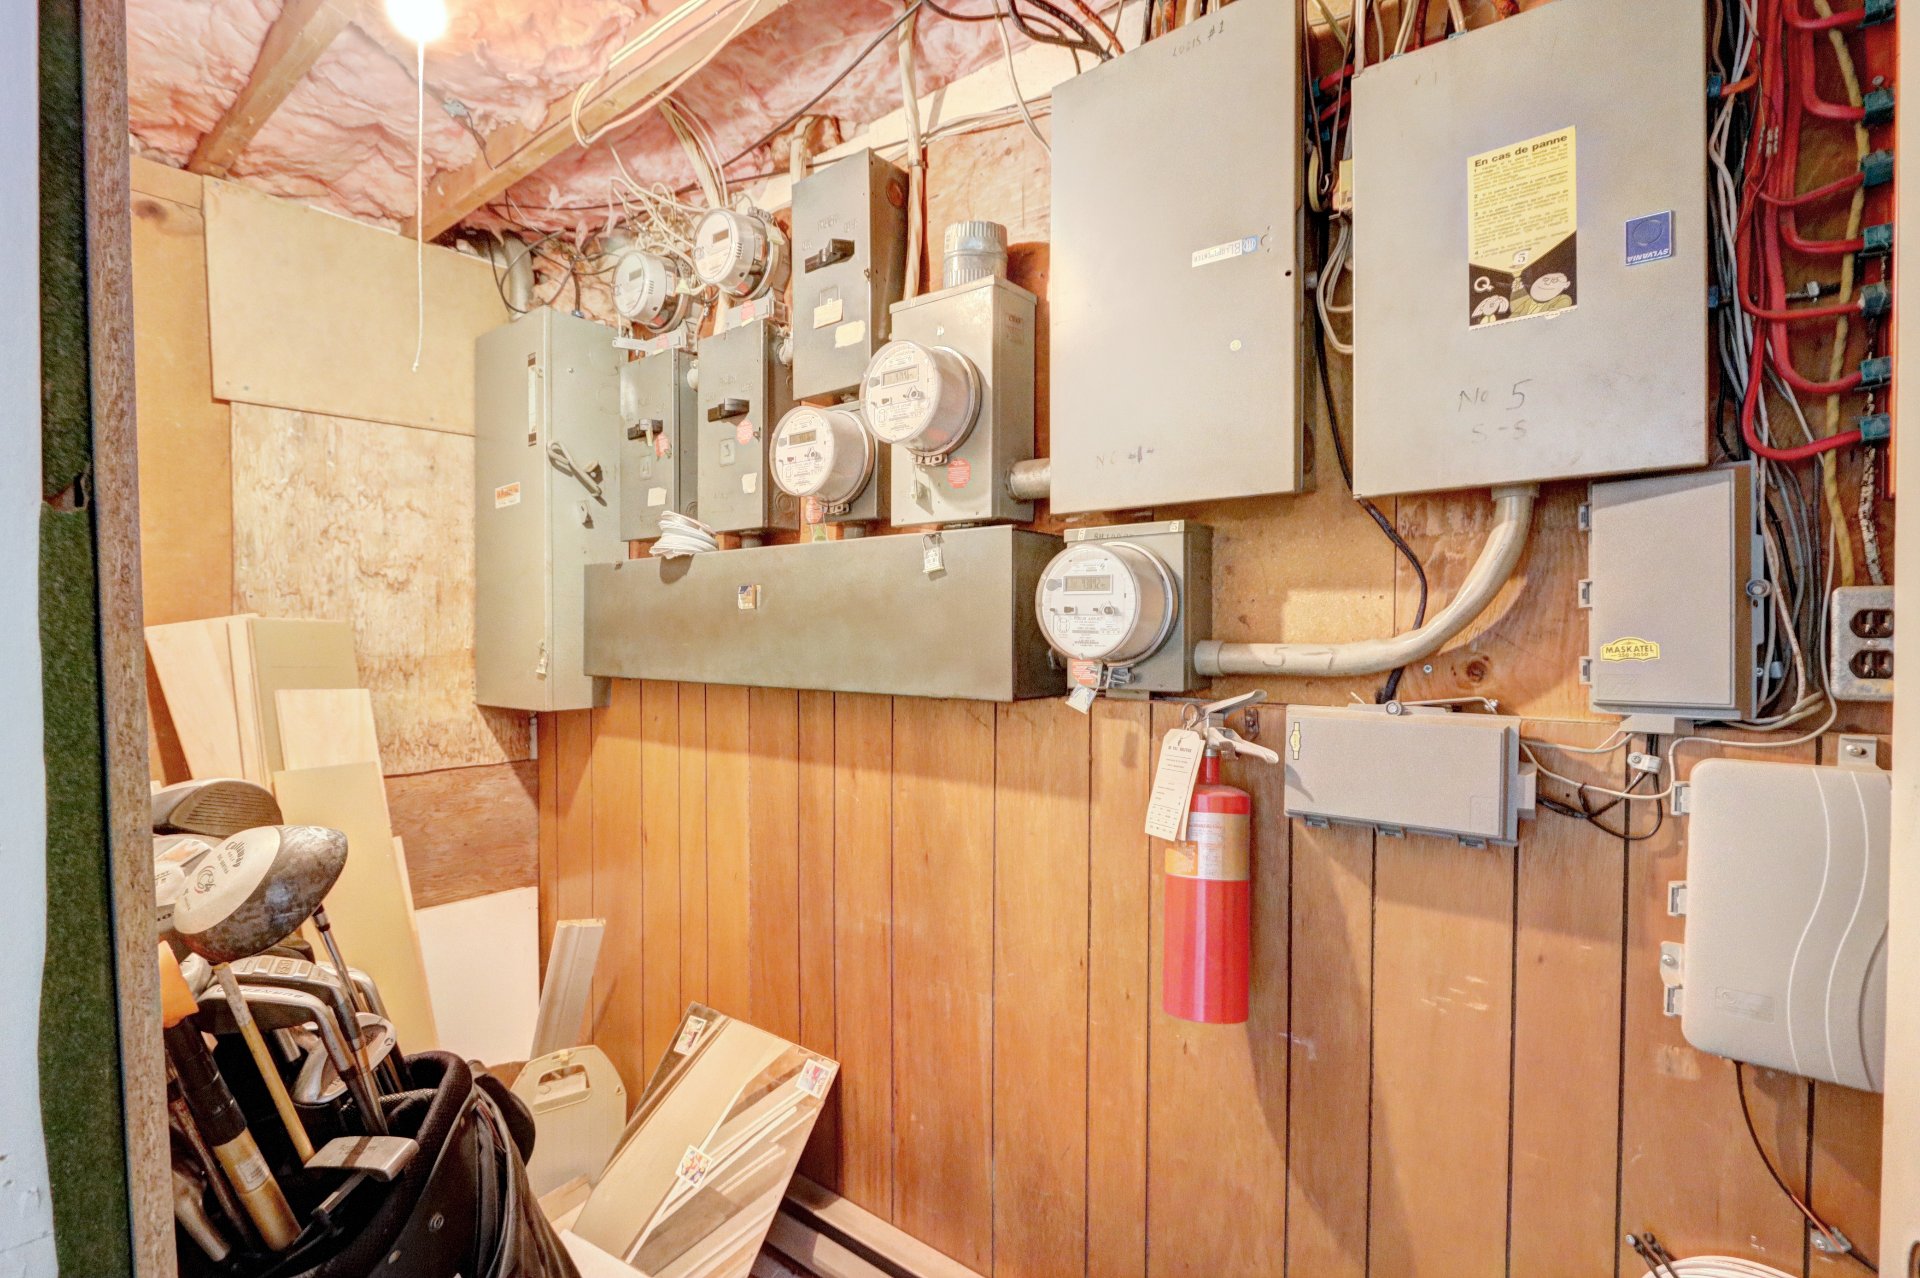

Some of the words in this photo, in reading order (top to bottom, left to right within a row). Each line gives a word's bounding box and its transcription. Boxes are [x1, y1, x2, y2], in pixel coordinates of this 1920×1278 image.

[1474, 159, 1489, 168] En
[1491, 152, 1511, 163] cas
[1514, 146, 1529, 156] de
[1531, 135, 1568, 152] panne
[1627, 248, 1669, 263] SYLVANIA
[1505, 379, 1534, 411] 5
[1605, 644, 1654, 653] MASKATEL
